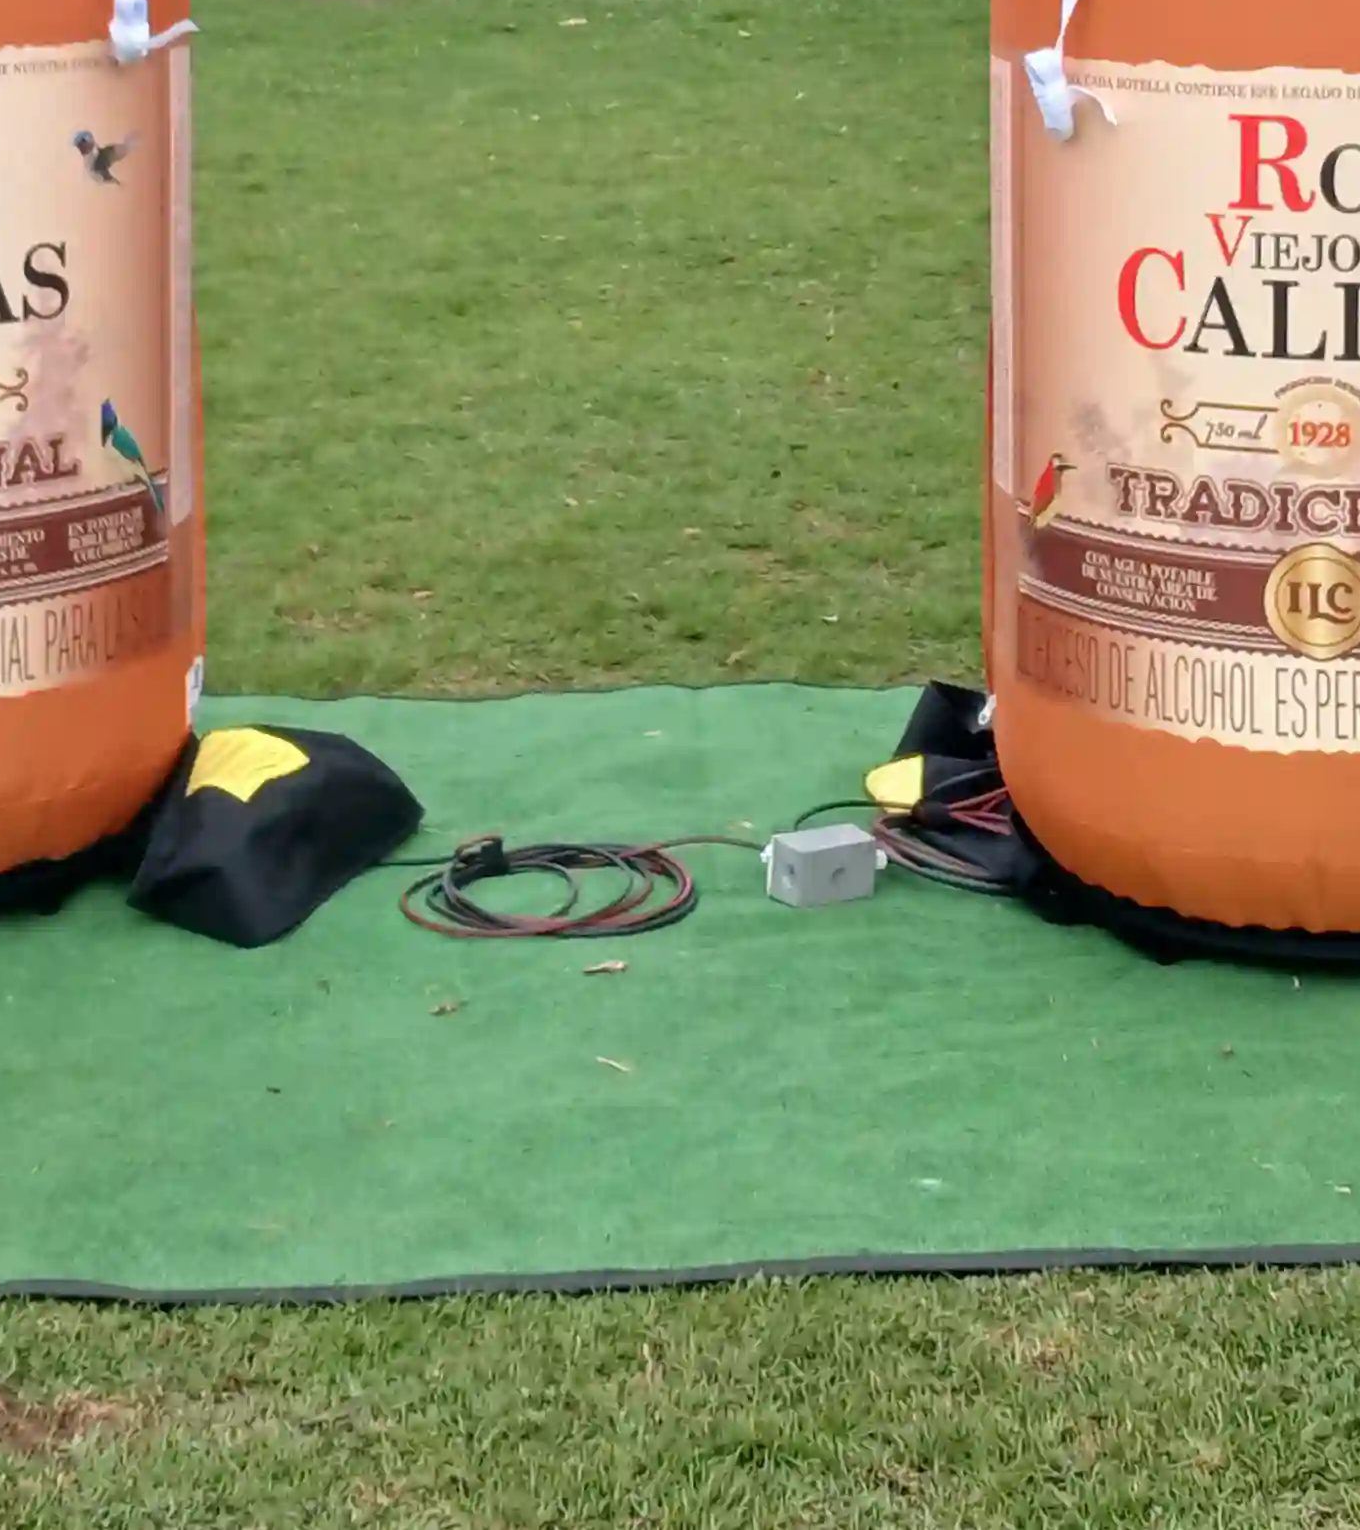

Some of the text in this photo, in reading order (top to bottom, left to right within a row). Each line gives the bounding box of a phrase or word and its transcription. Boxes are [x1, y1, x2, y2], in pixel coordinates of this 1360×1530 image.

[1116, 76, 1172, 94] BOTELLA
[1174, 80, 1248, 98] CONTIENE
[1204, 420, 1235, 446] 750
[1288, 421, 1352, 449] 1928
[1150, 563, 1217, 587] POTABLE
[1287, 580, 1355, 622] ILC
[44, 605, 98, 676] PARA
[1109, 641, 1136, 715] DE
[1145, 650, 1263, 735] ALCOHOL
[1274, 667, 1308, 738] ES
